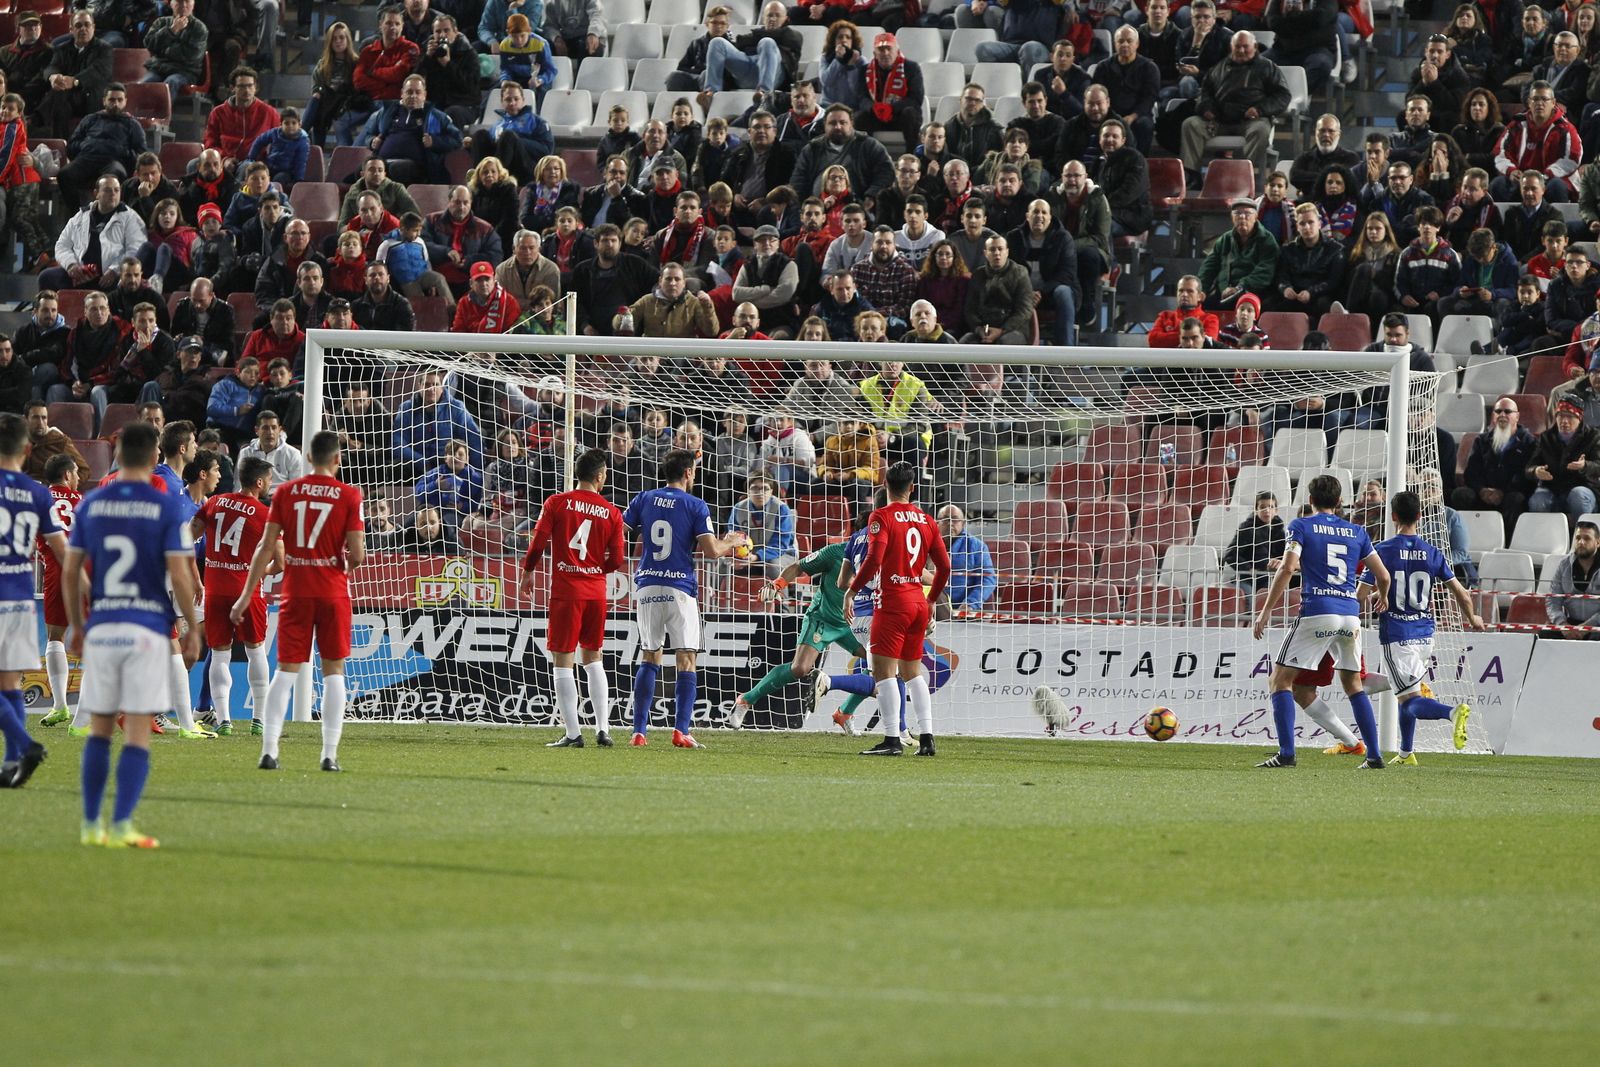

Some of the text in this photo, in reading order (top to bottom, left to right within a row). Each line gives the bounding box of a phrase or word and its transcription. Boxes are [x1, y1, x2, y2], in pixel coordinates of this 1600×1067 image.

[216, 497, 256, 516] TRUJILLO
[291, 484, 341, 499] A. PUERTAS
[566, 499, 609, 519] X. NAVARRO
[653, 496, 676, 509] TOCHÉ
[214, 512, 246, 557] 14
[294, 501, 333, 549] 17
[894, 511, 927, 525] QUIQUE
[1312, 524, 1357, 538] DAVID FDEZ.
[569, 519, 592, 561] 4
[651, 520, 673, 562] 9
[906, 526, 922, 568] 9
[103, 535, 139, 597] 2
[665, 569, 687, 579] Auto
[1326, 543, 1348, 586] 5
[640, 594, 675, 605] telecable
[1394, 570, 1431, 612] 10
[266, 611, 757, 668] OWERAE
[1314, 629, 1353, 639] telecable
[1249, 646, 1504, 684] ARÍA
[393, 691, 487, 720] para
[499, 685, 732, 725] deortsas
[972, 683, 1071, 698] PATRONTO
[1077, 687, 1178, 700] PROVINCIAL
[1183, 689, 1207, 700] DE
[1212, 690, 1273, 702] TURISM
